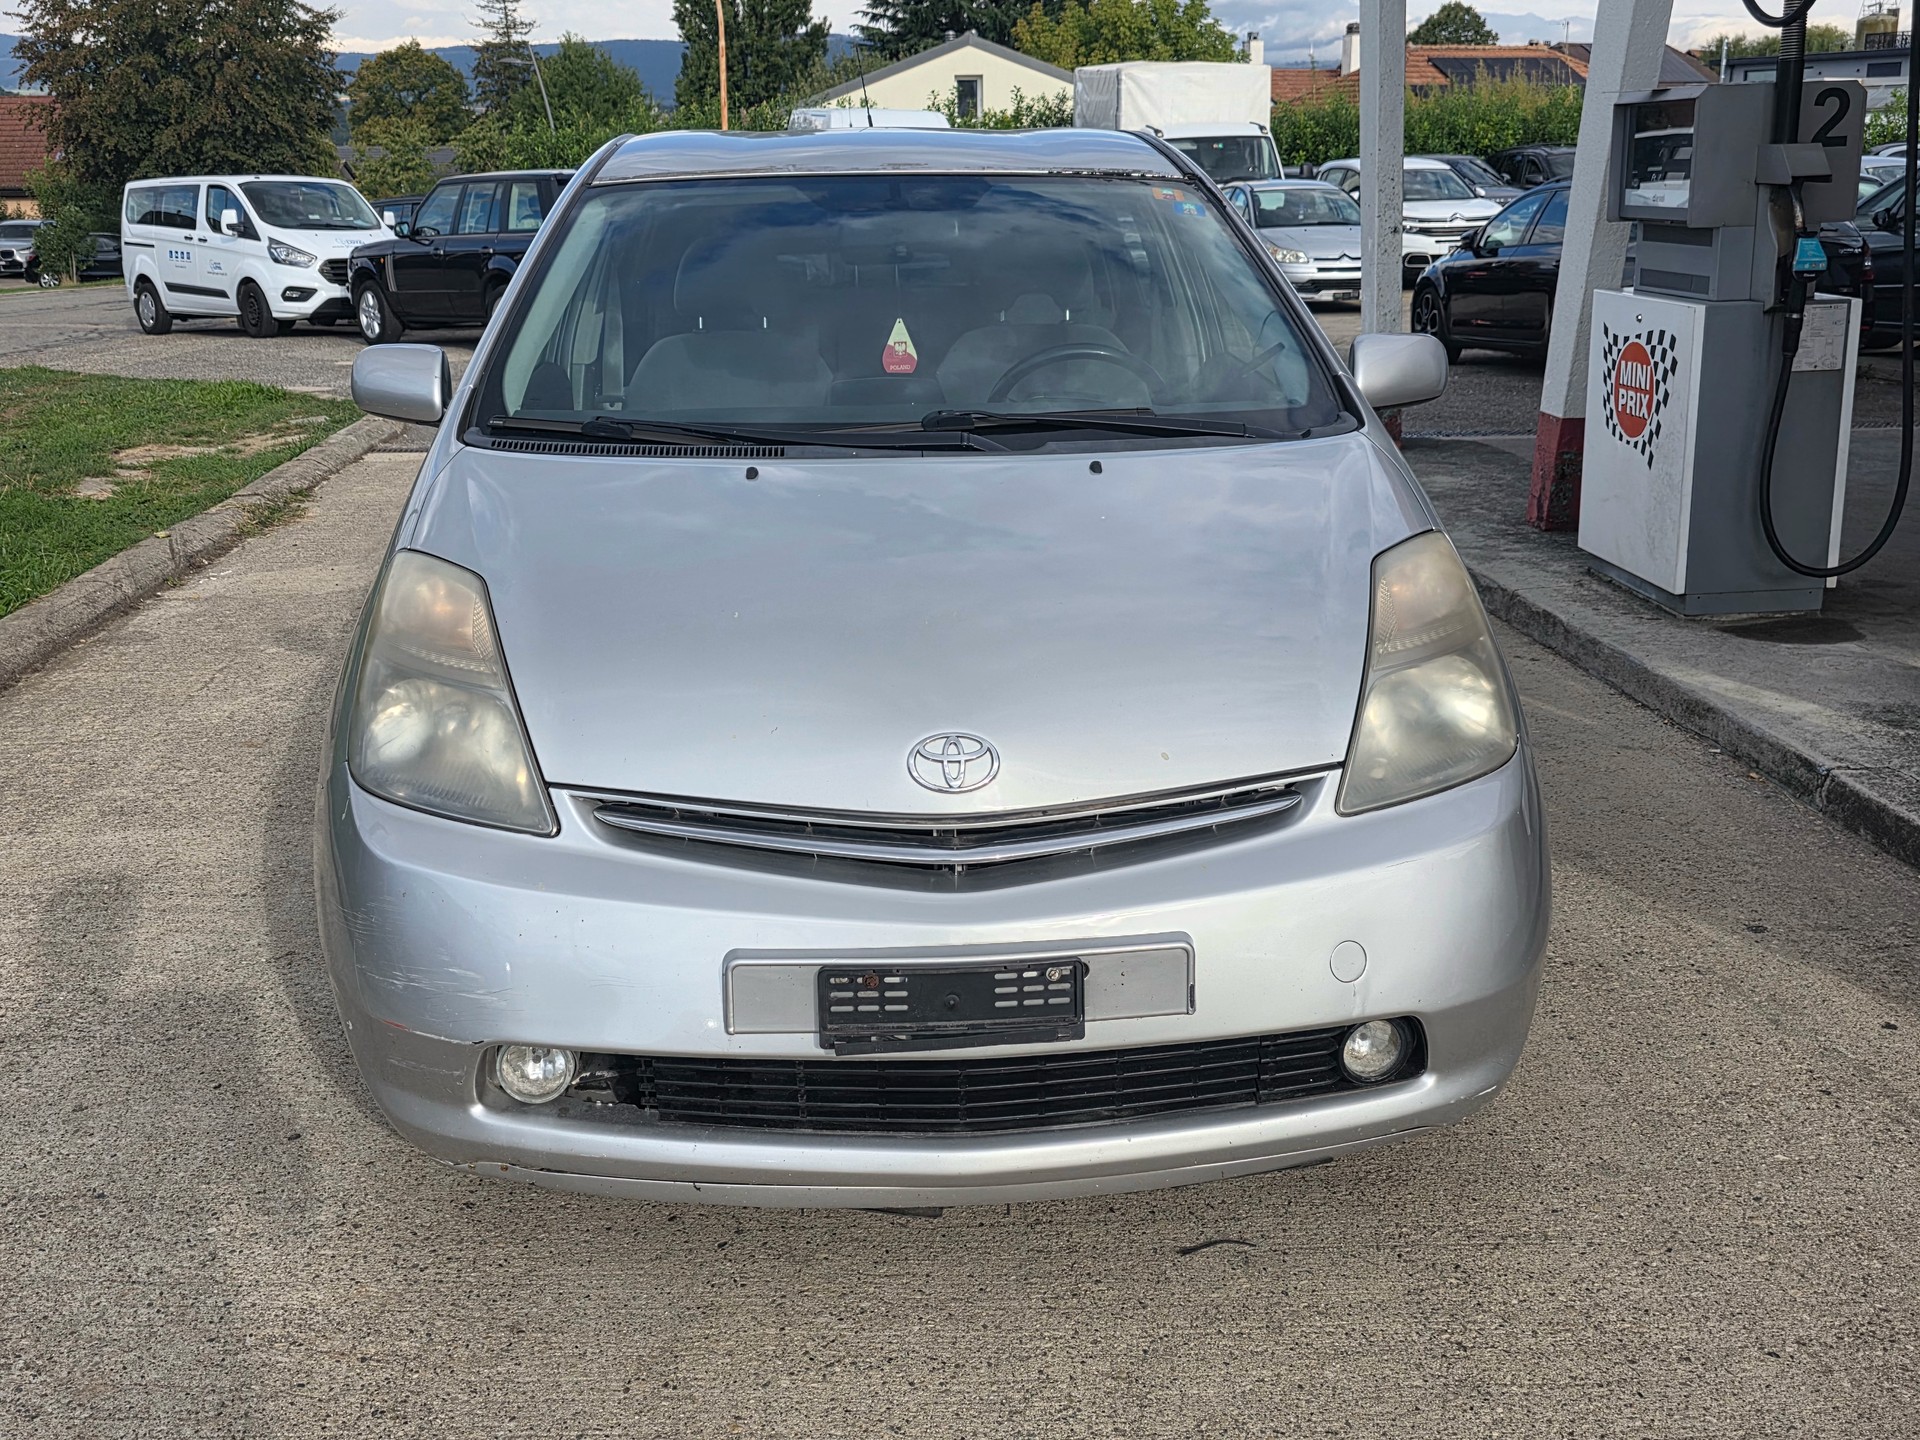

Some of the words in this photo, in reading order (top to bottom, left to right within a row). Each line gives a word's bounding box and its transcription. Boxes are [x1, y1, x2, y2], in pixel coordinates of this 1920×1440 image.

[1812, 87, 1850, 147] 2
[1619, 360, 1652, 391] MINI
[1617, 388, 1650, 421] PRIX
